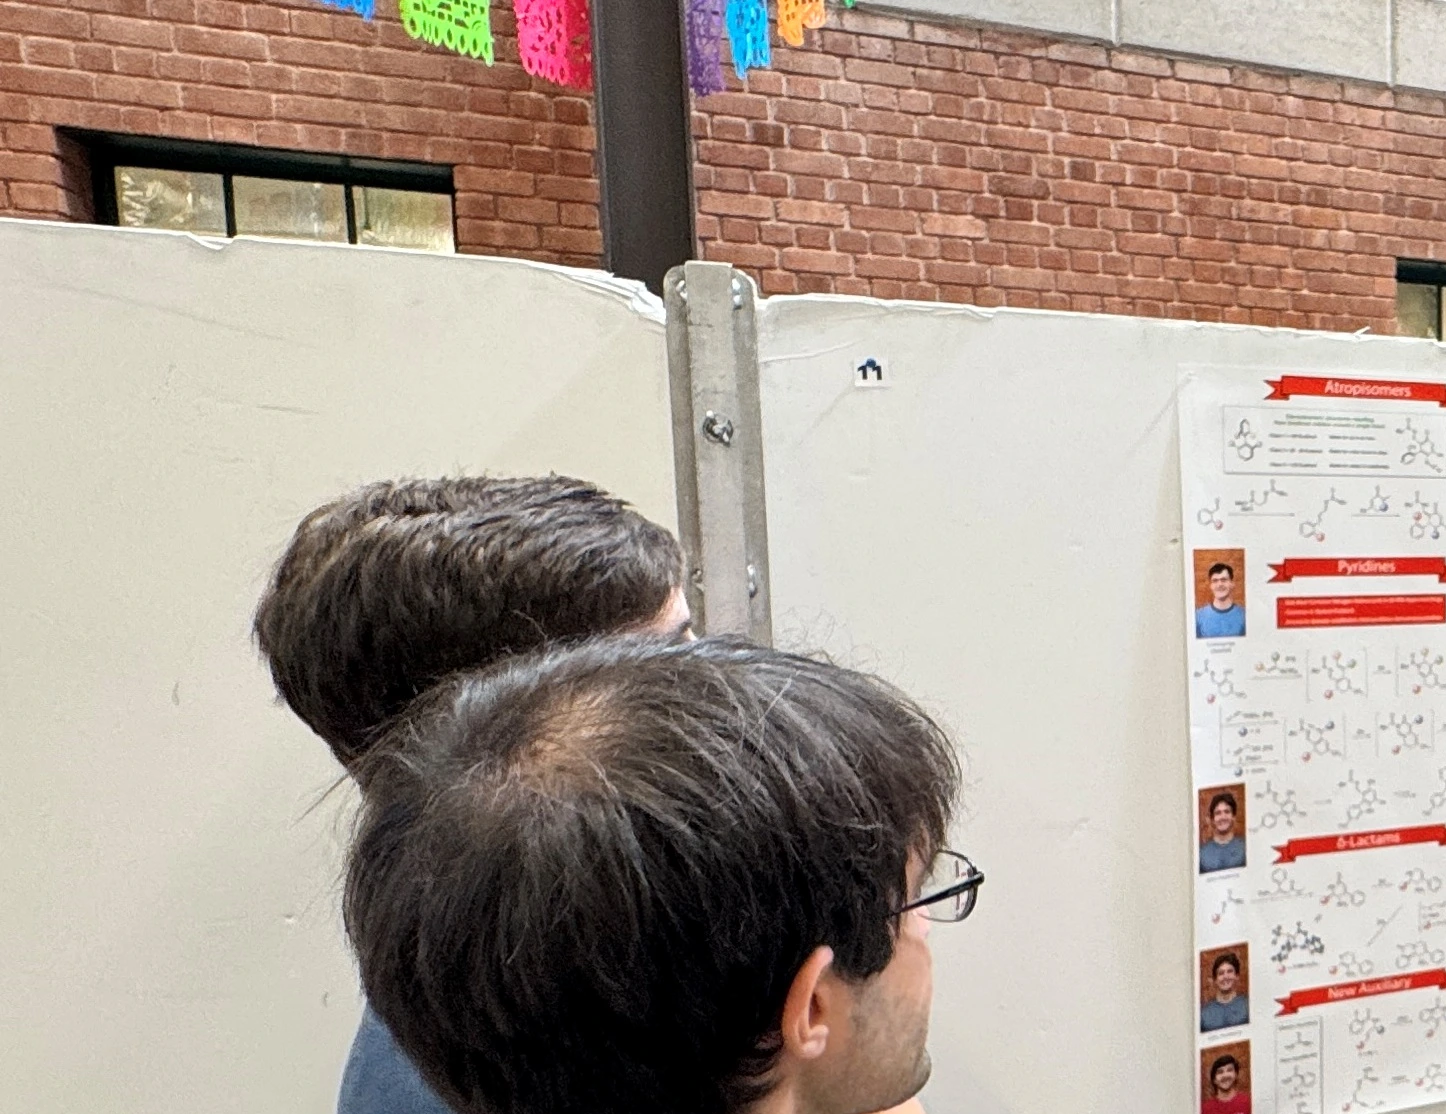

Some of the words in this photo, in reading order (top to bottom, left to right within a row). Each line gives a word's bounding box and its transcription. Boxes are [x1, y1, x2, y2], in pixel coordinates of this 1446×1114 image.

[857, 365, 883, 381] 11
[1324, 379, 1412, 398] Atropisomers
[1337, 559, 1396, 574] Pyridines
[1327, 985, 1358, 1000] New
[1358, 977, 1413, 995] Auxiliary
